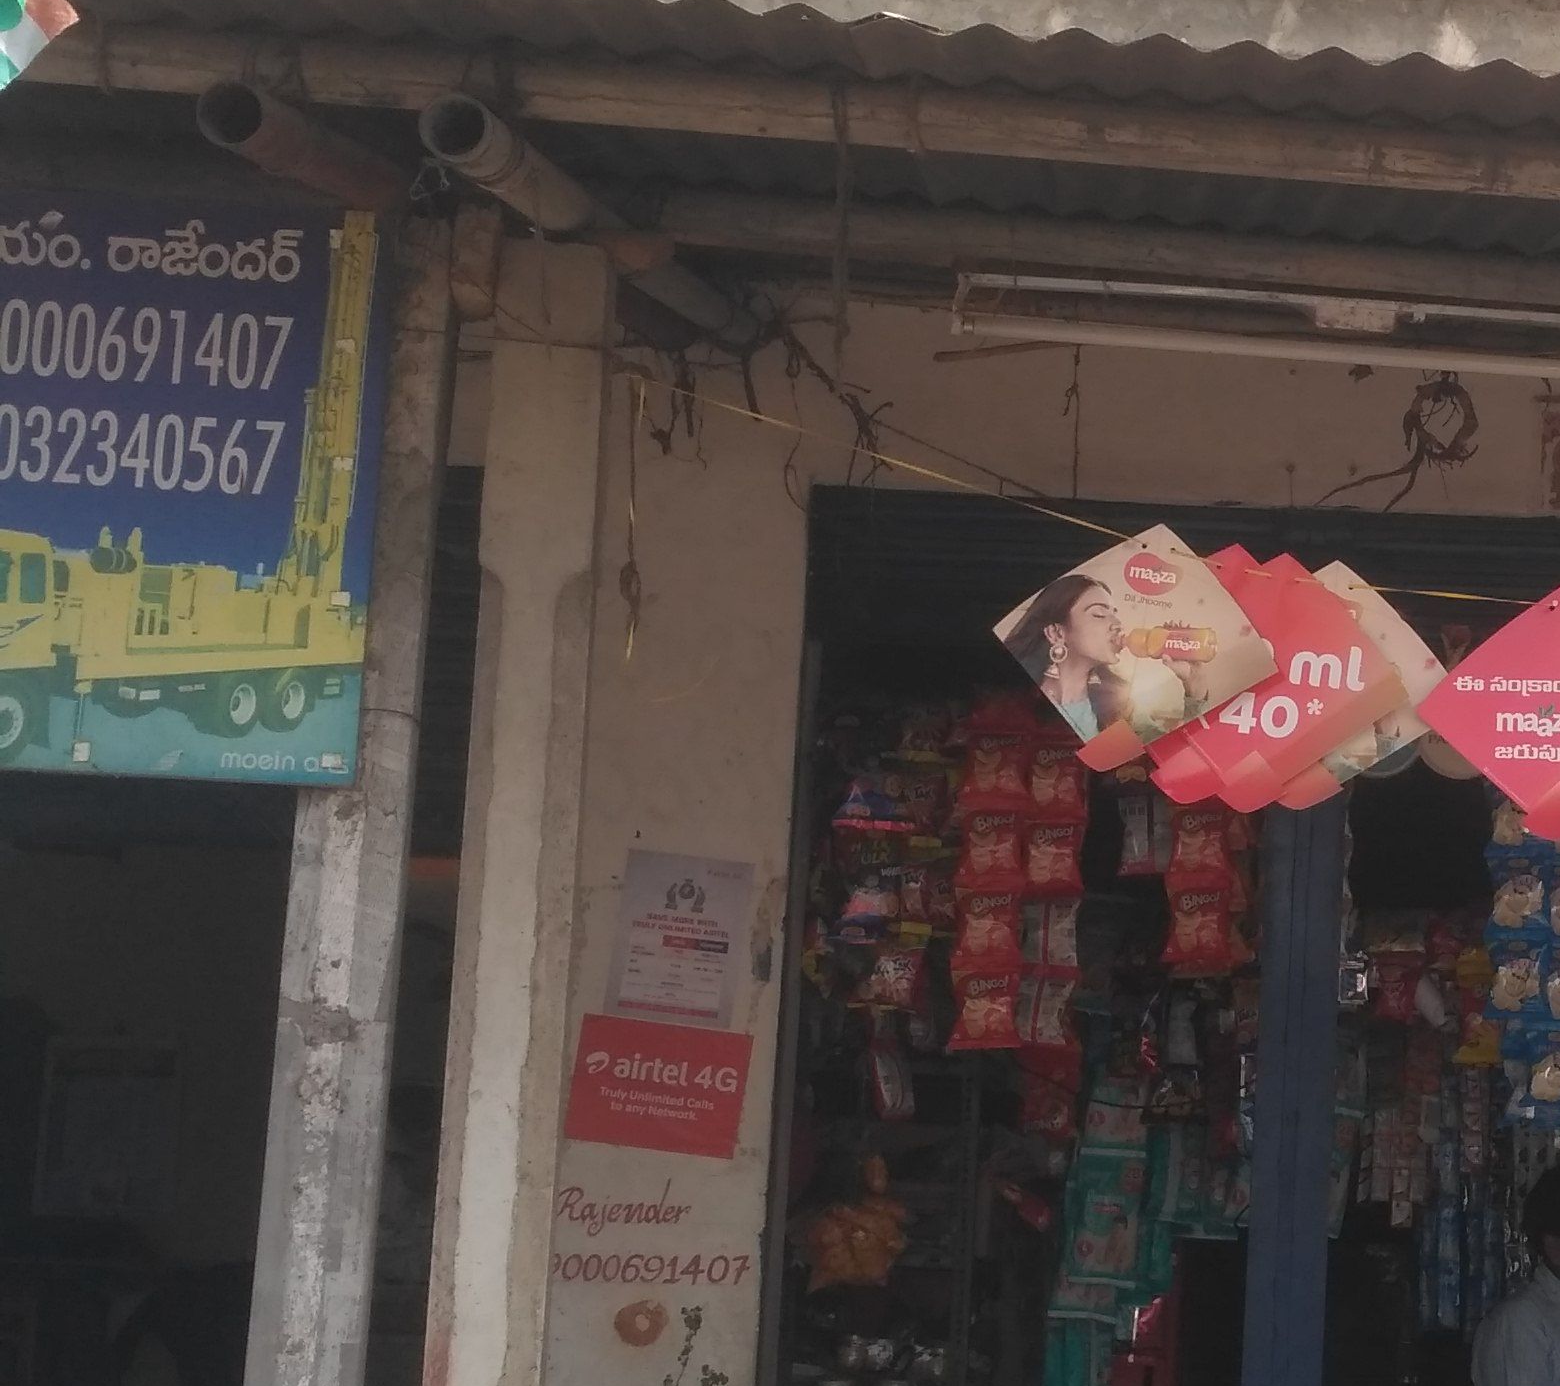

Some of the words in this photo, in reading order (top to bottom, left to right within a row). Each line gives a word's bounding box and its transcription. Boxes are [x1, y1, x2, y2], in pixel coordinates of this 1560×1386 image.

[108, 219, 303, 283] రాజేందర్
[1129, 565, 1176, 584] maaza
[1165, 638, 1200, 651] maaza
[1289, 646, 1366, 691] ml
[1453, 677, 1484, 692] ఈ
[613, 1053, 688, 1087] airtel
[694, 1065, 738, 1092] 4G
[600, 1086, 628, 1100] Truly
[630, 1090, 684, 1107] Unlimited
[687, 1099, 715, 1111] Calls
[610, 1102, 623, 1111] to
[625, 1104, 646, 1116] any
[557, 1178, 692, 1237] Rajender
